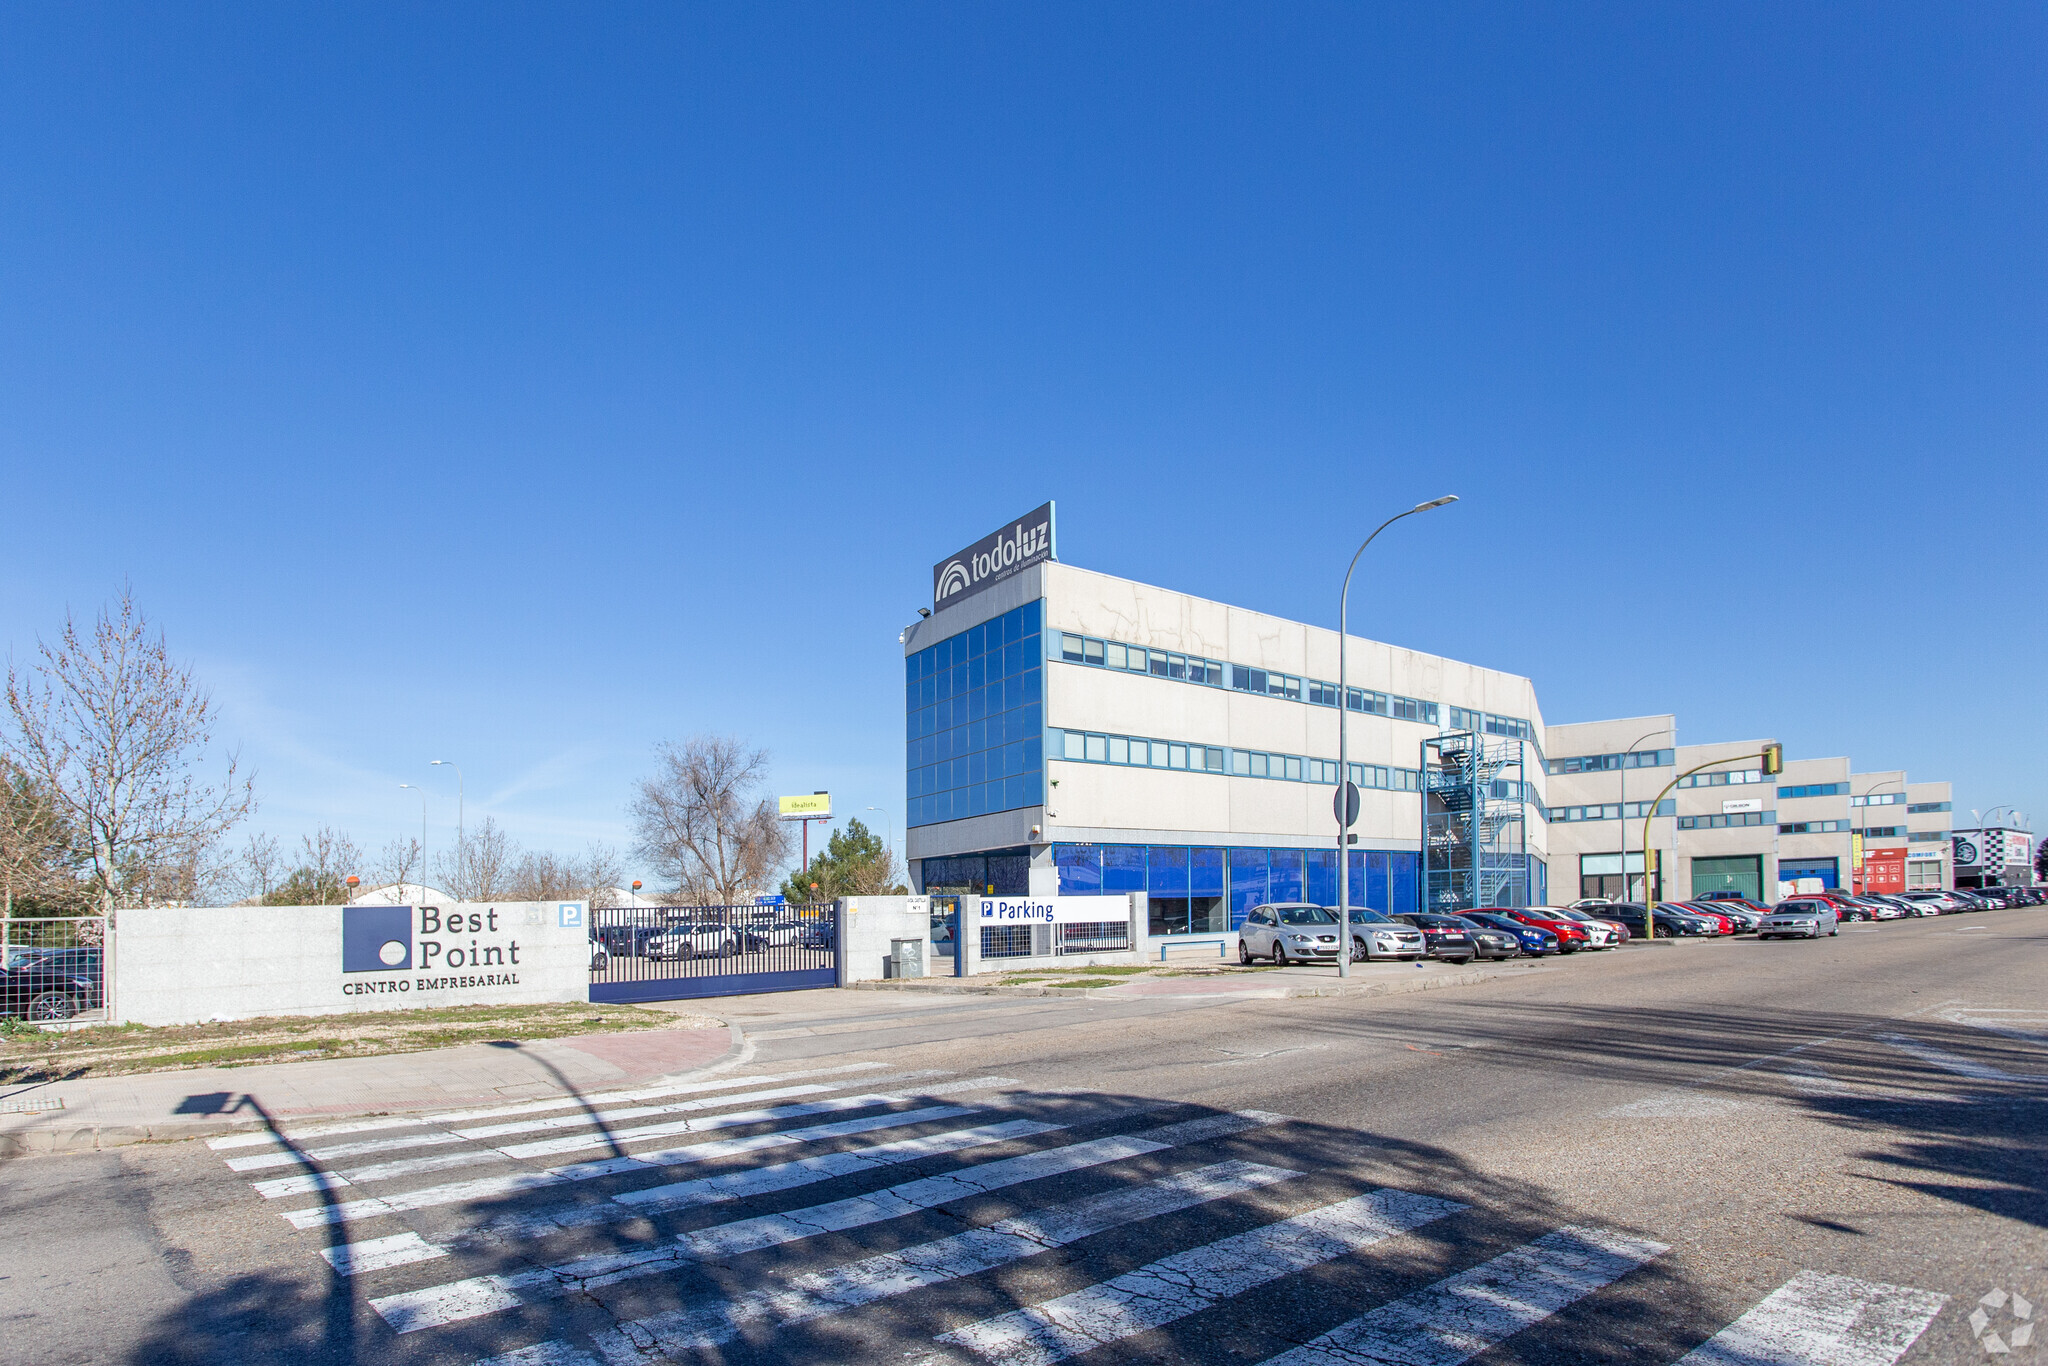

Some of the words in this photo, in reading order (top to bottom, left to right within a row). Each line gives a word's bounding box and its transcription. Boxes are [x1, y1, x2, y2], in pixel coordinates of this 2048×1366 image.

[971, 521, 1049, 583] todoluz
[994, 567, 1013, 581] centros
[1013, 563, 1020, 572] de
[419, 906, 499, 935] Best
[999, 900, 1054, 922] Parking
[419, 940, 520, 970] Point
[343, 980, 411, 996] CENTRO
[417, 973, 520, 991] EMPRESARIAL
